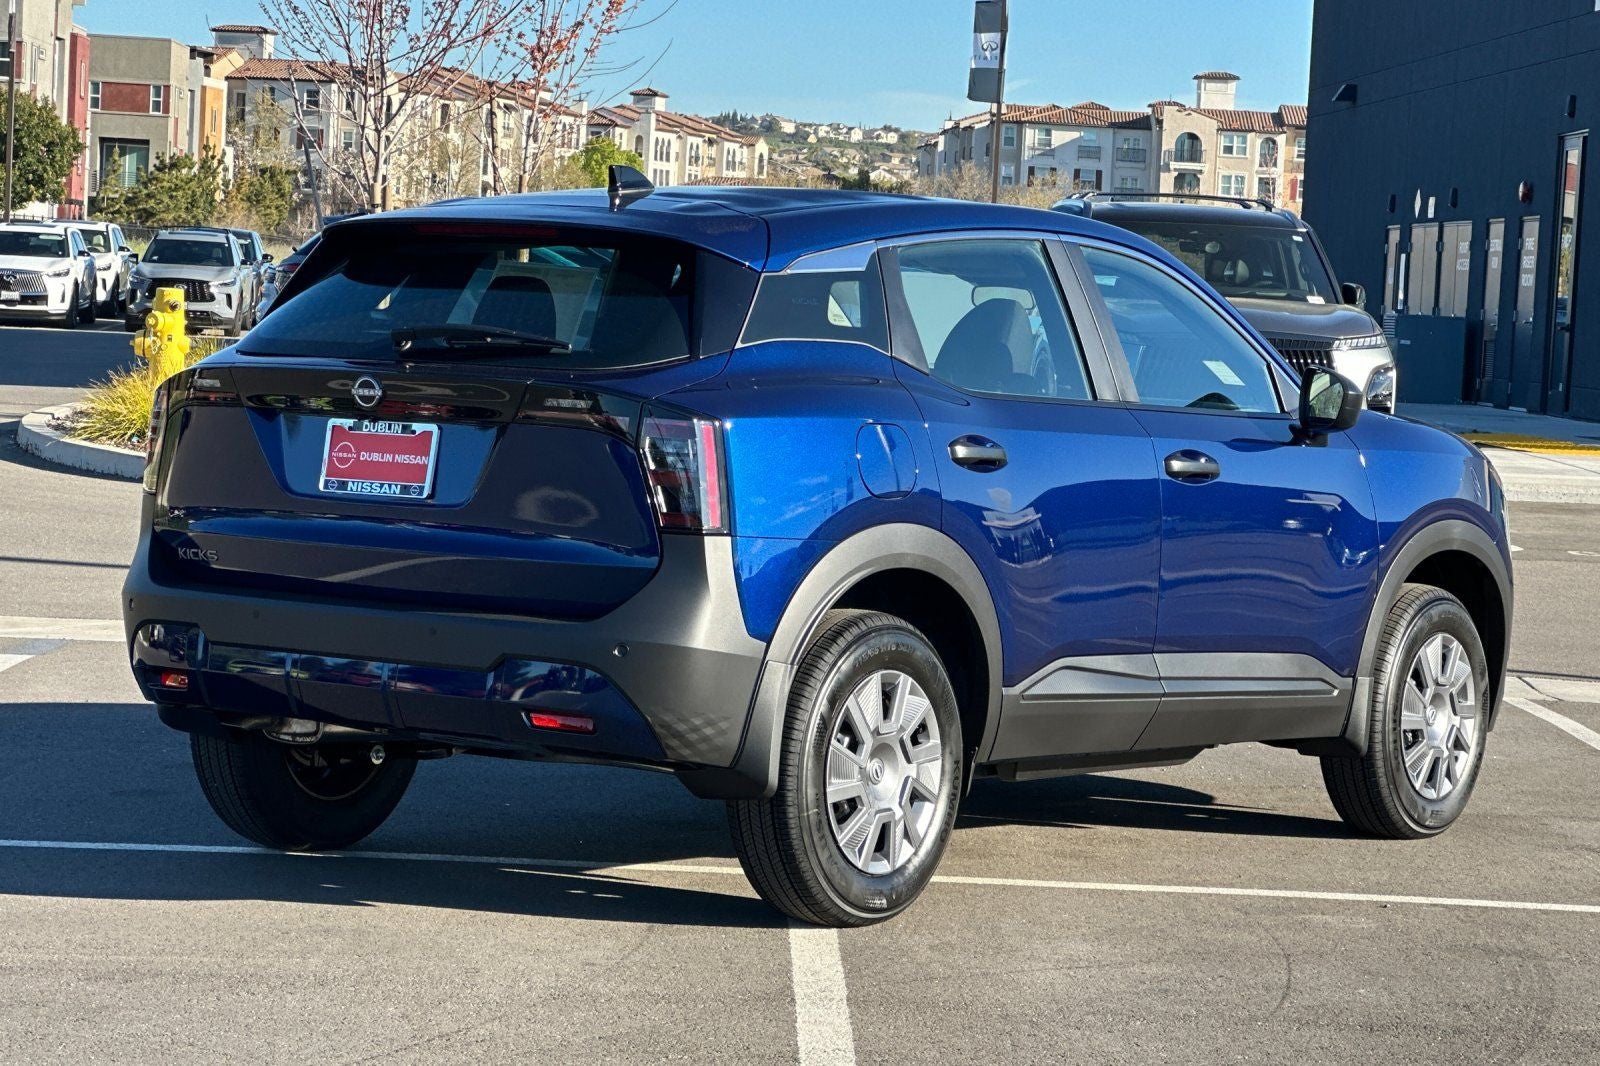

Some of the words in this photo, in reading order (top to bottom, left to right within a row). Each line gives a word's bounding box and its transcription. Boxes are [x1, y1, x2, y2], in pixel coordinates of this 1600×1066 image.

[352, 388, 382, 396] NISSAN
[362, 421, 402, 434] DUBLIN
[331, 451, 357, 459] NISSAN
[360, 451, 393, 462] DUBLIN
[394, 454, 429, 465] NISSAN
[347, 481, 401, 495] NISSAN
[178, 547, 218, 561] KICKS
